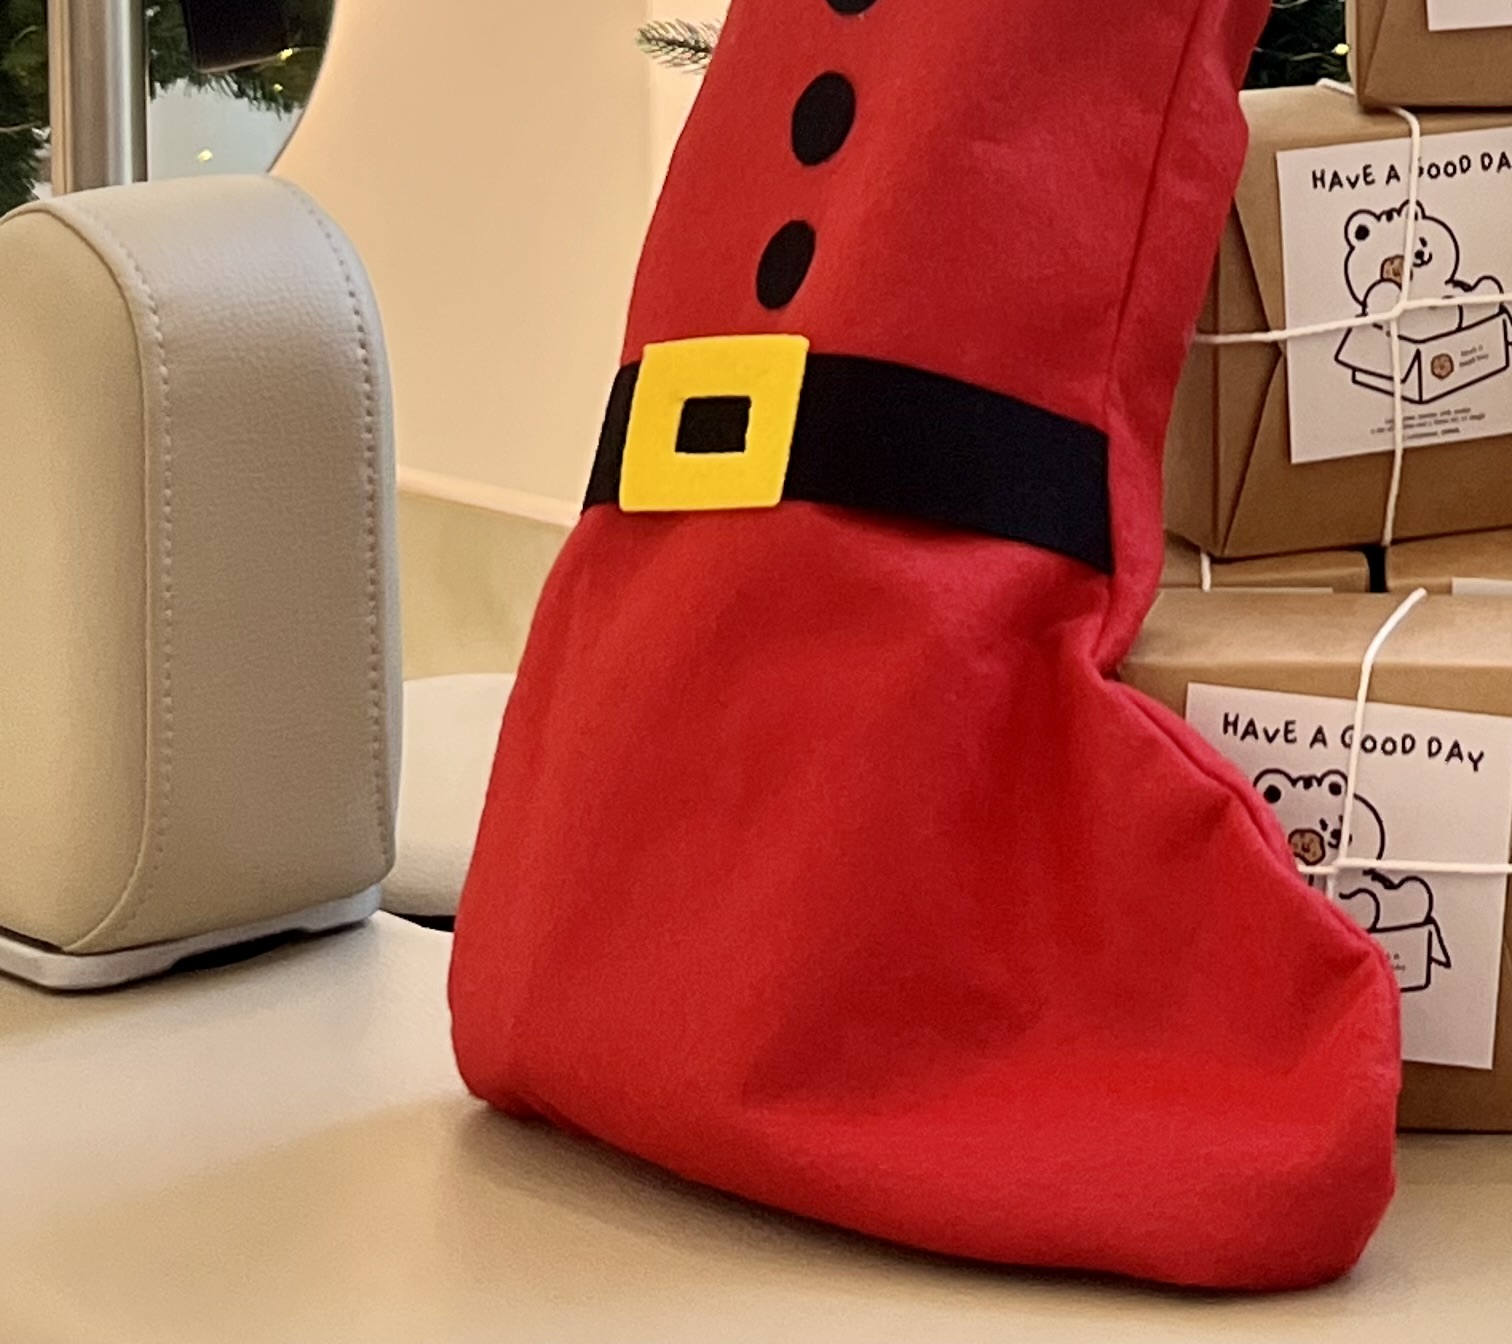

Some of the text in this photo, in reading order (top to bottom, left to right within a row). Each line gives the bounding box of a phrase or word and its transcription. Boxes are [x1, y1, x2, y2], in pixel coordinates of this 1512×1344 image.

[1311, 164, 1376, 192] HAVE
[1385, 164, 1401, 186] A
[1222, 712, 1484, 772] HAVE A GOOD DAY
